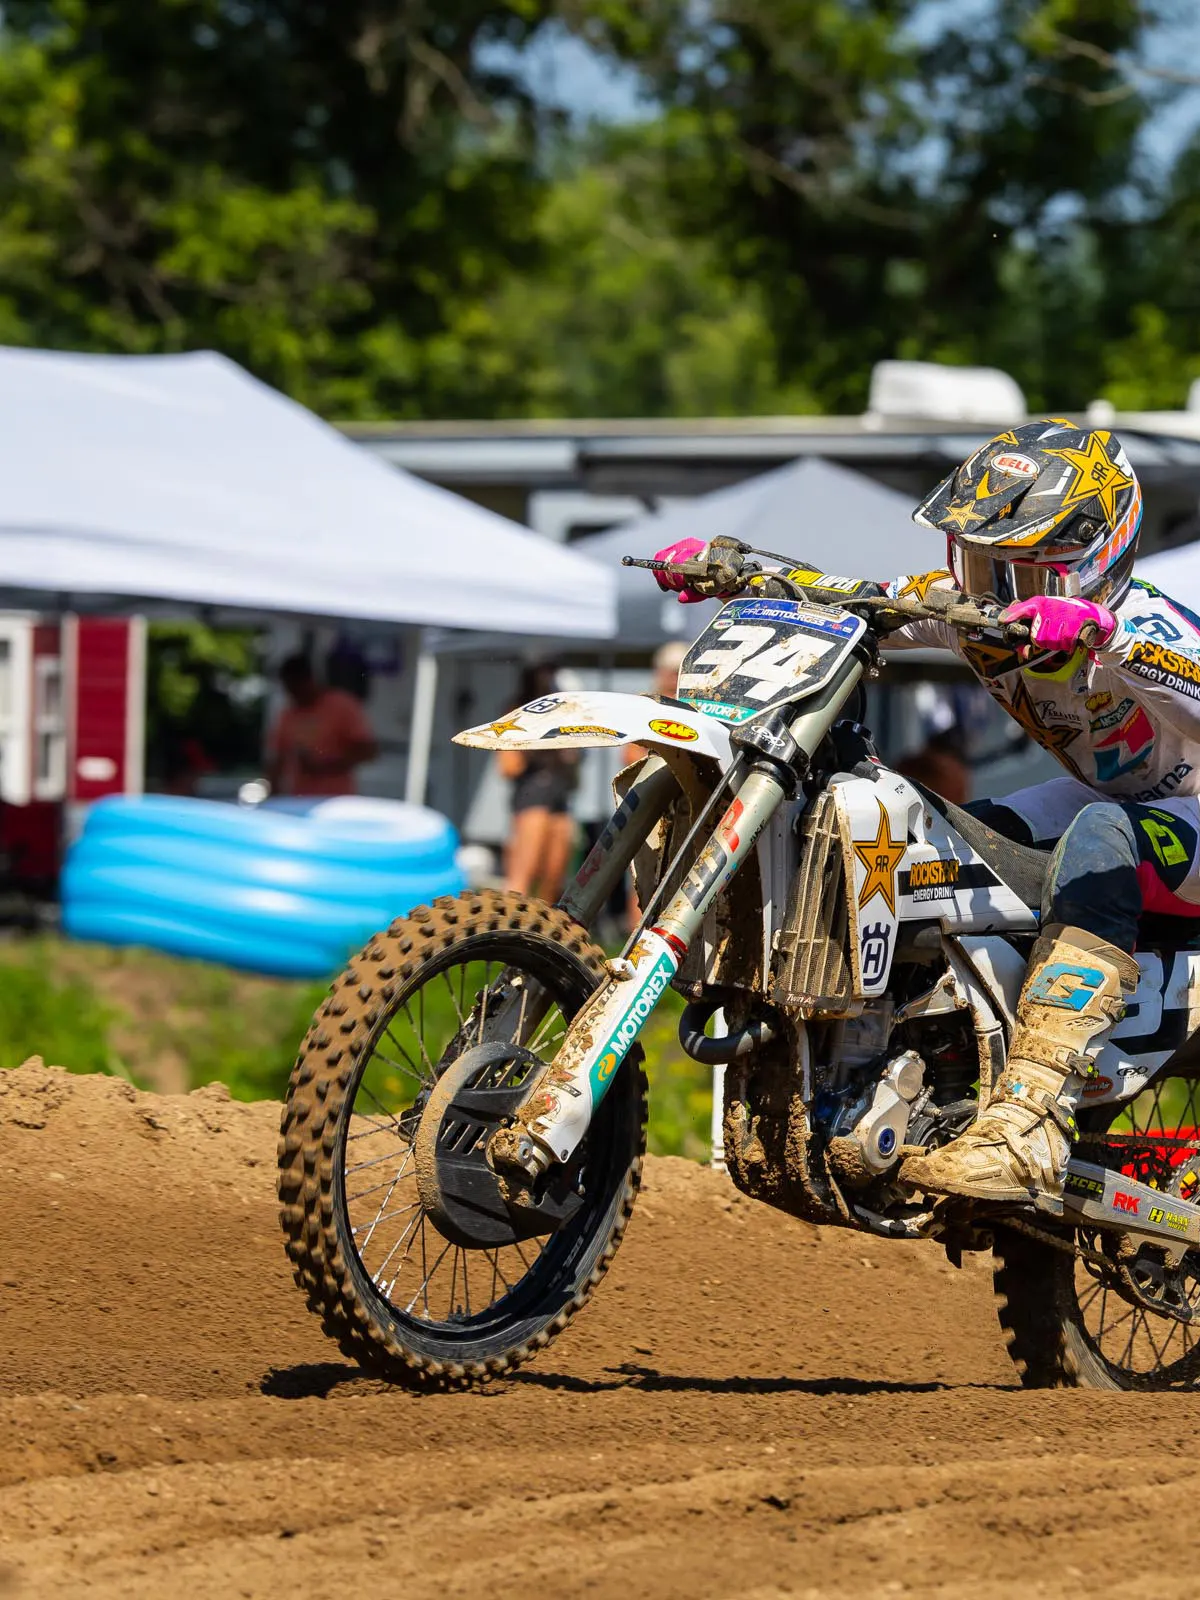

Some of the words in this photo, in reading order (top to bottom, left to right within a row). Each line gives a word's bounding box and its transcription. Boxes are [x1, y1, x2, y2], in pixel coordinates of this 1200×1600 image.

[997, 457, 1031, 473] BELL
[679, 625, 837, 702] 34
[650, 720, 698, 741] FMF
[913, 888, 934, 901] ENERGY
[933, 886, 955, 900] DRINK
[614, 965, 673, 1057] MOTOREX
[1112, 1191, 1141, 1214] RK
